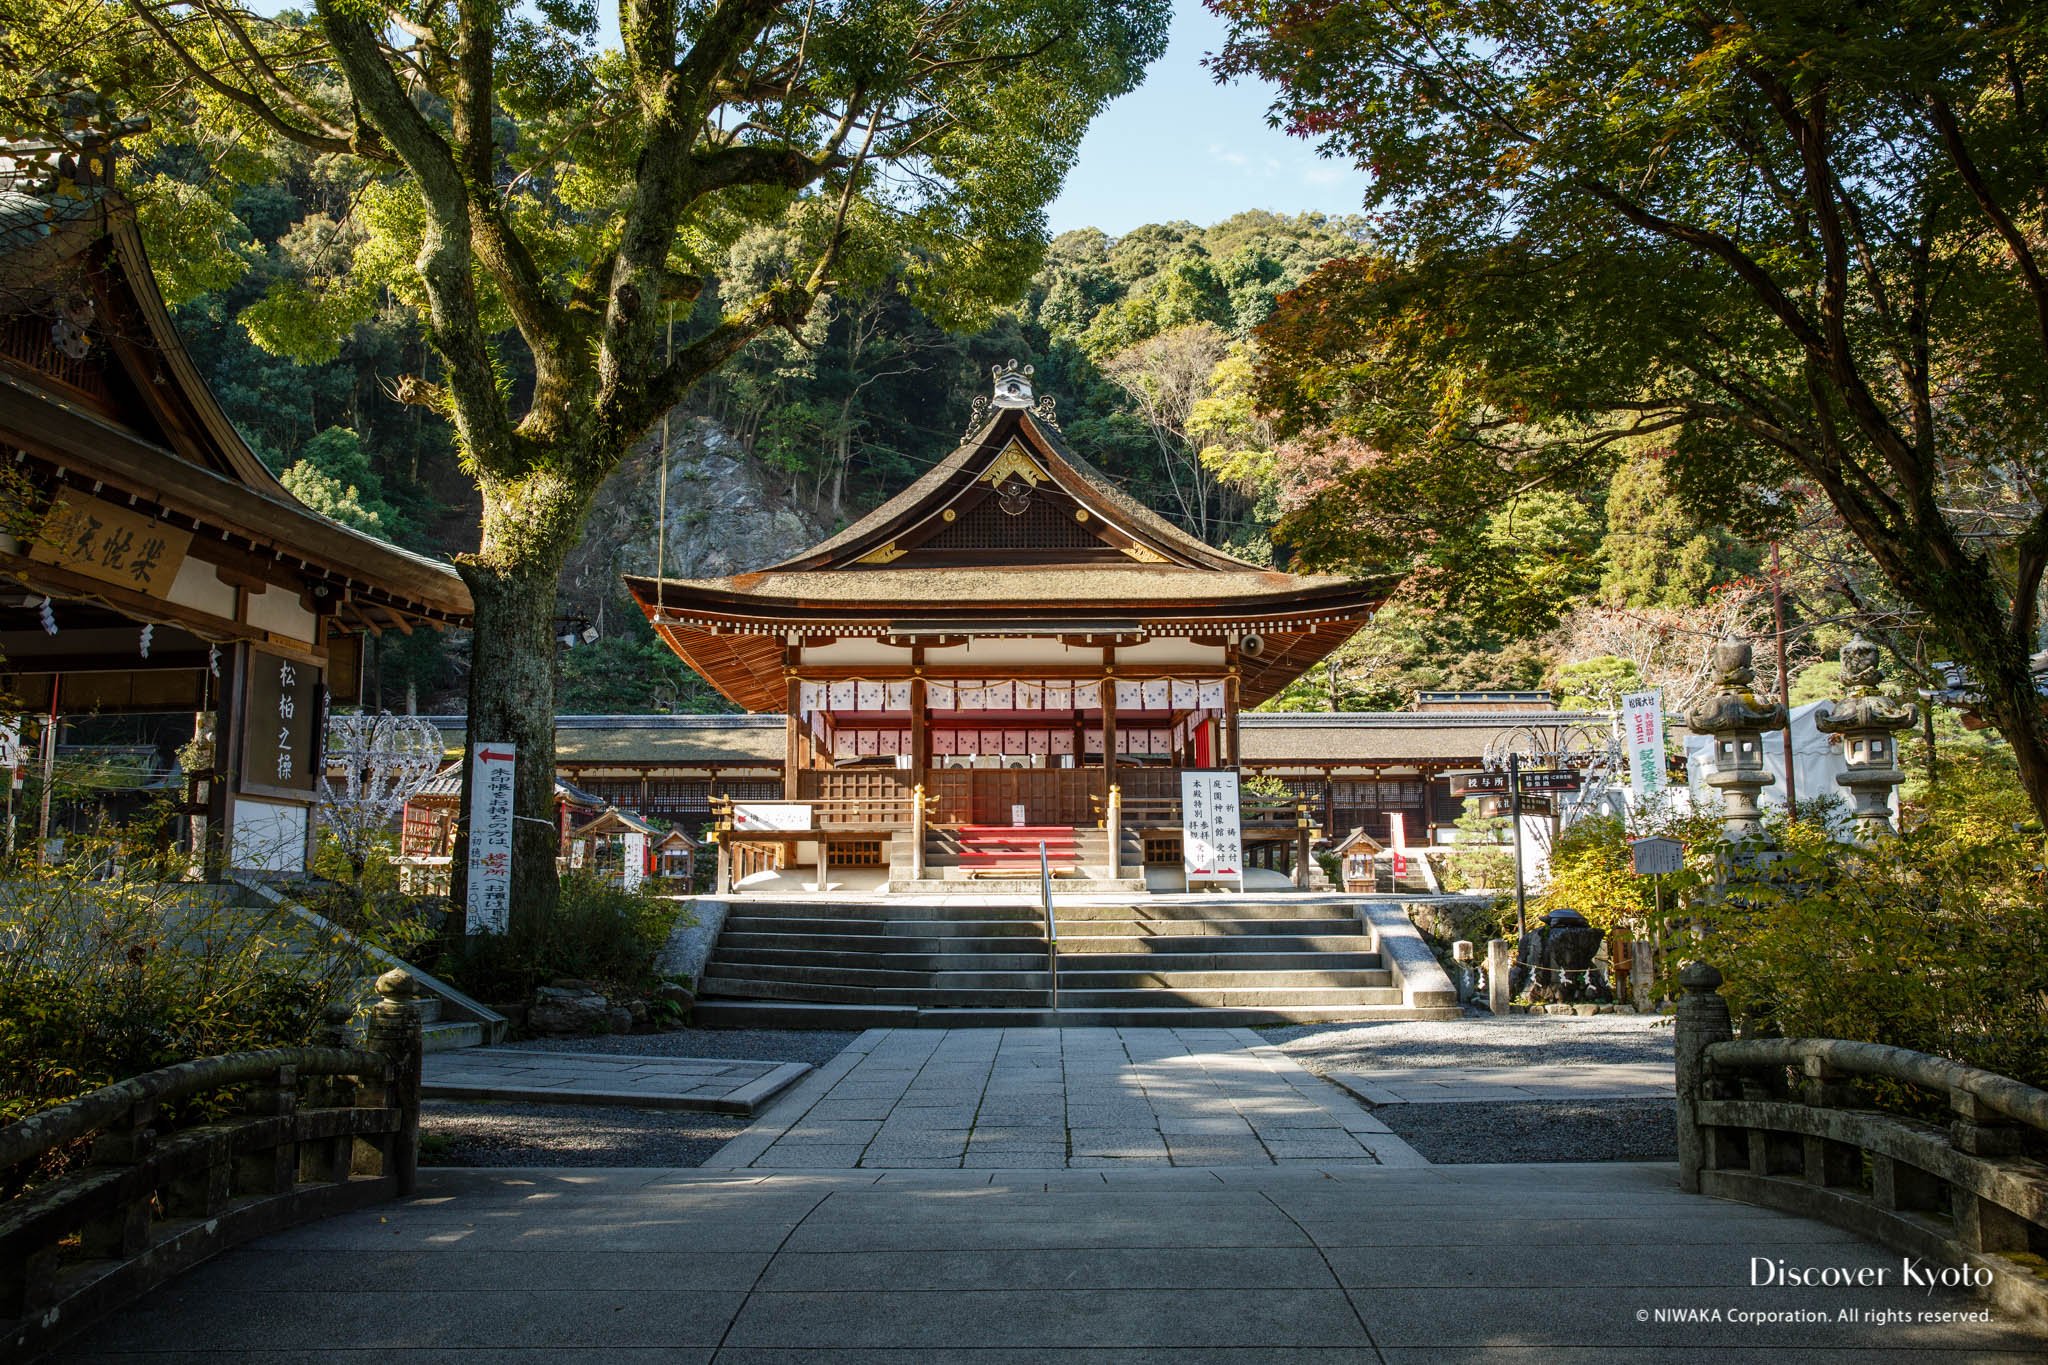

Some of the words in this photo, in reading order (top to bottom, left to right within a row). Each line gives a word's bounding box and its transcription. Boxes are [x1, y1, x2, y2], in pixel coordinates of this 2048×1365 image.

[277, 659, 296, 781] 松柏之操
[1634, 713, 1645, 745] 七五三
[1192, 779, 1203, 819] 本殿特別
[1467, 777, 1505, 788] 授与所
